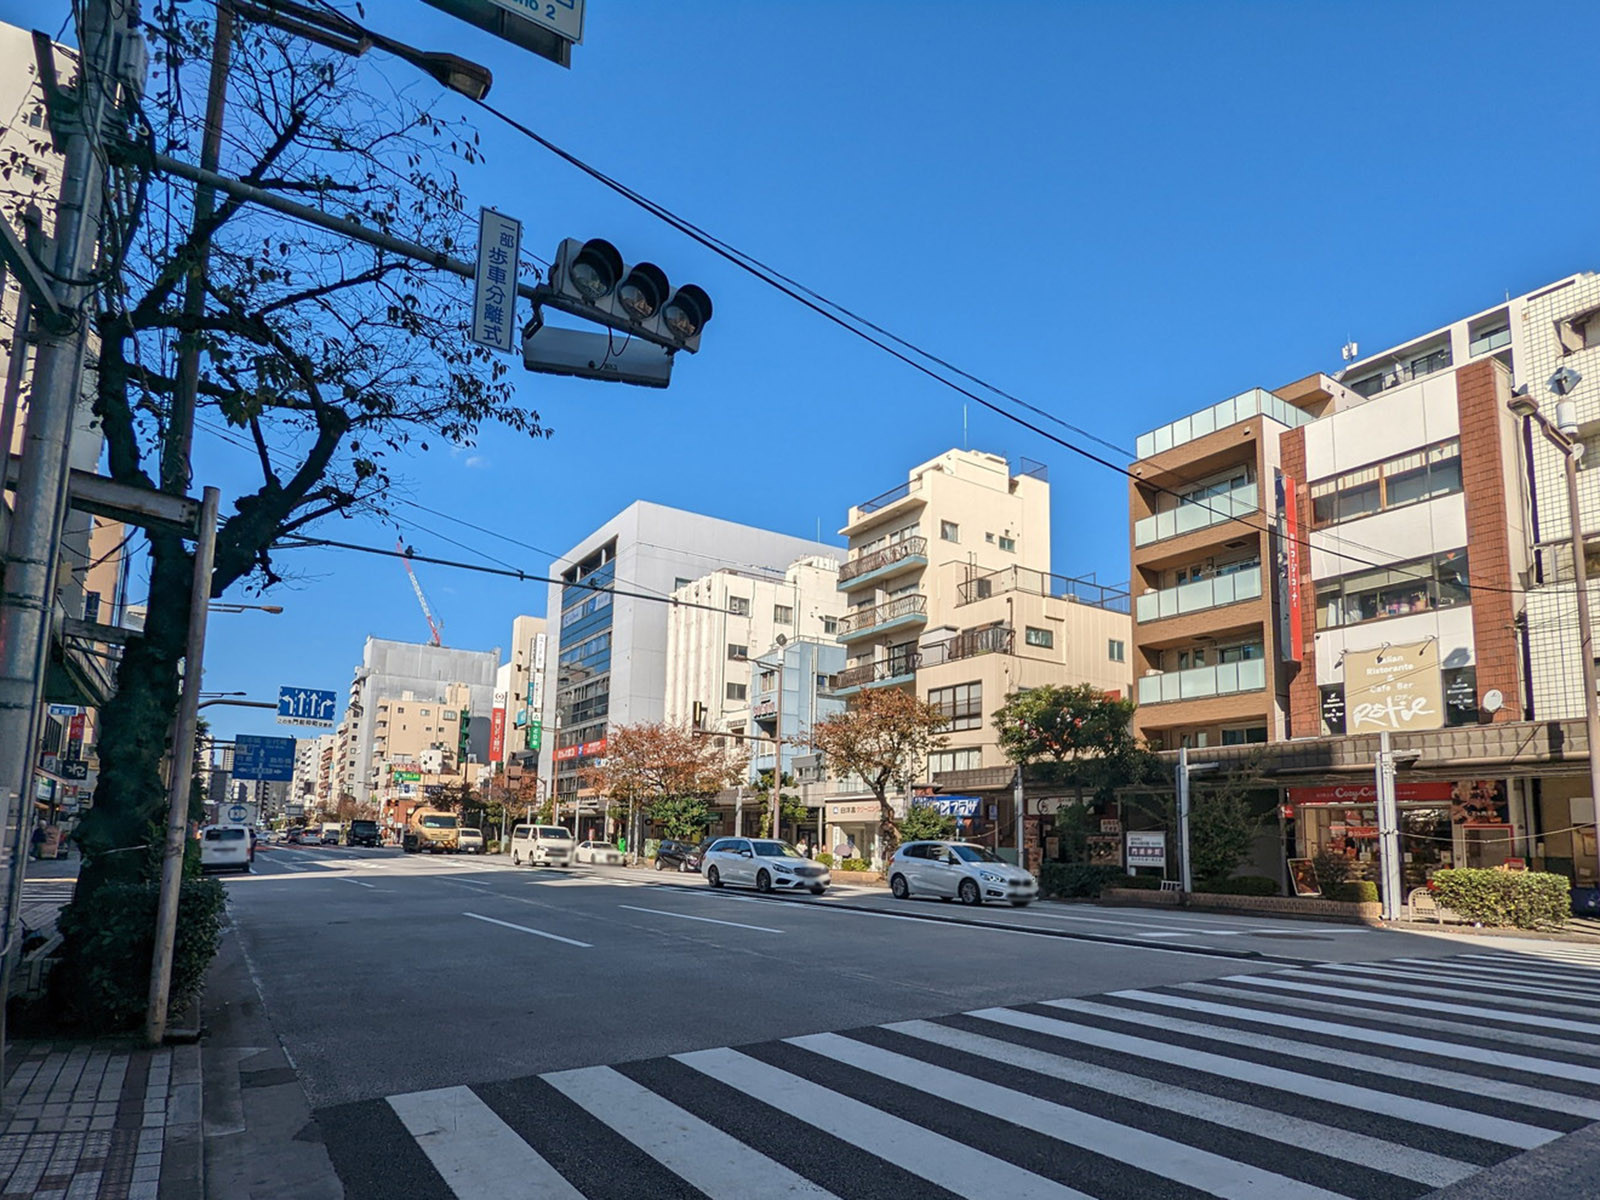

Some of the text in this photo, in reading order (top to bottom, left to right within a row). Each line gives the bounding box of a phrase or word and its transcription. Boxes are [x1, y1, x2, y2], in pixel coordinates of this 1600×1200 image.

[499, 223, 516, 249] 一部
[482, 246, 508, 345] 歩車分離式
[1366, 664, 1414, 676] Ristorante
